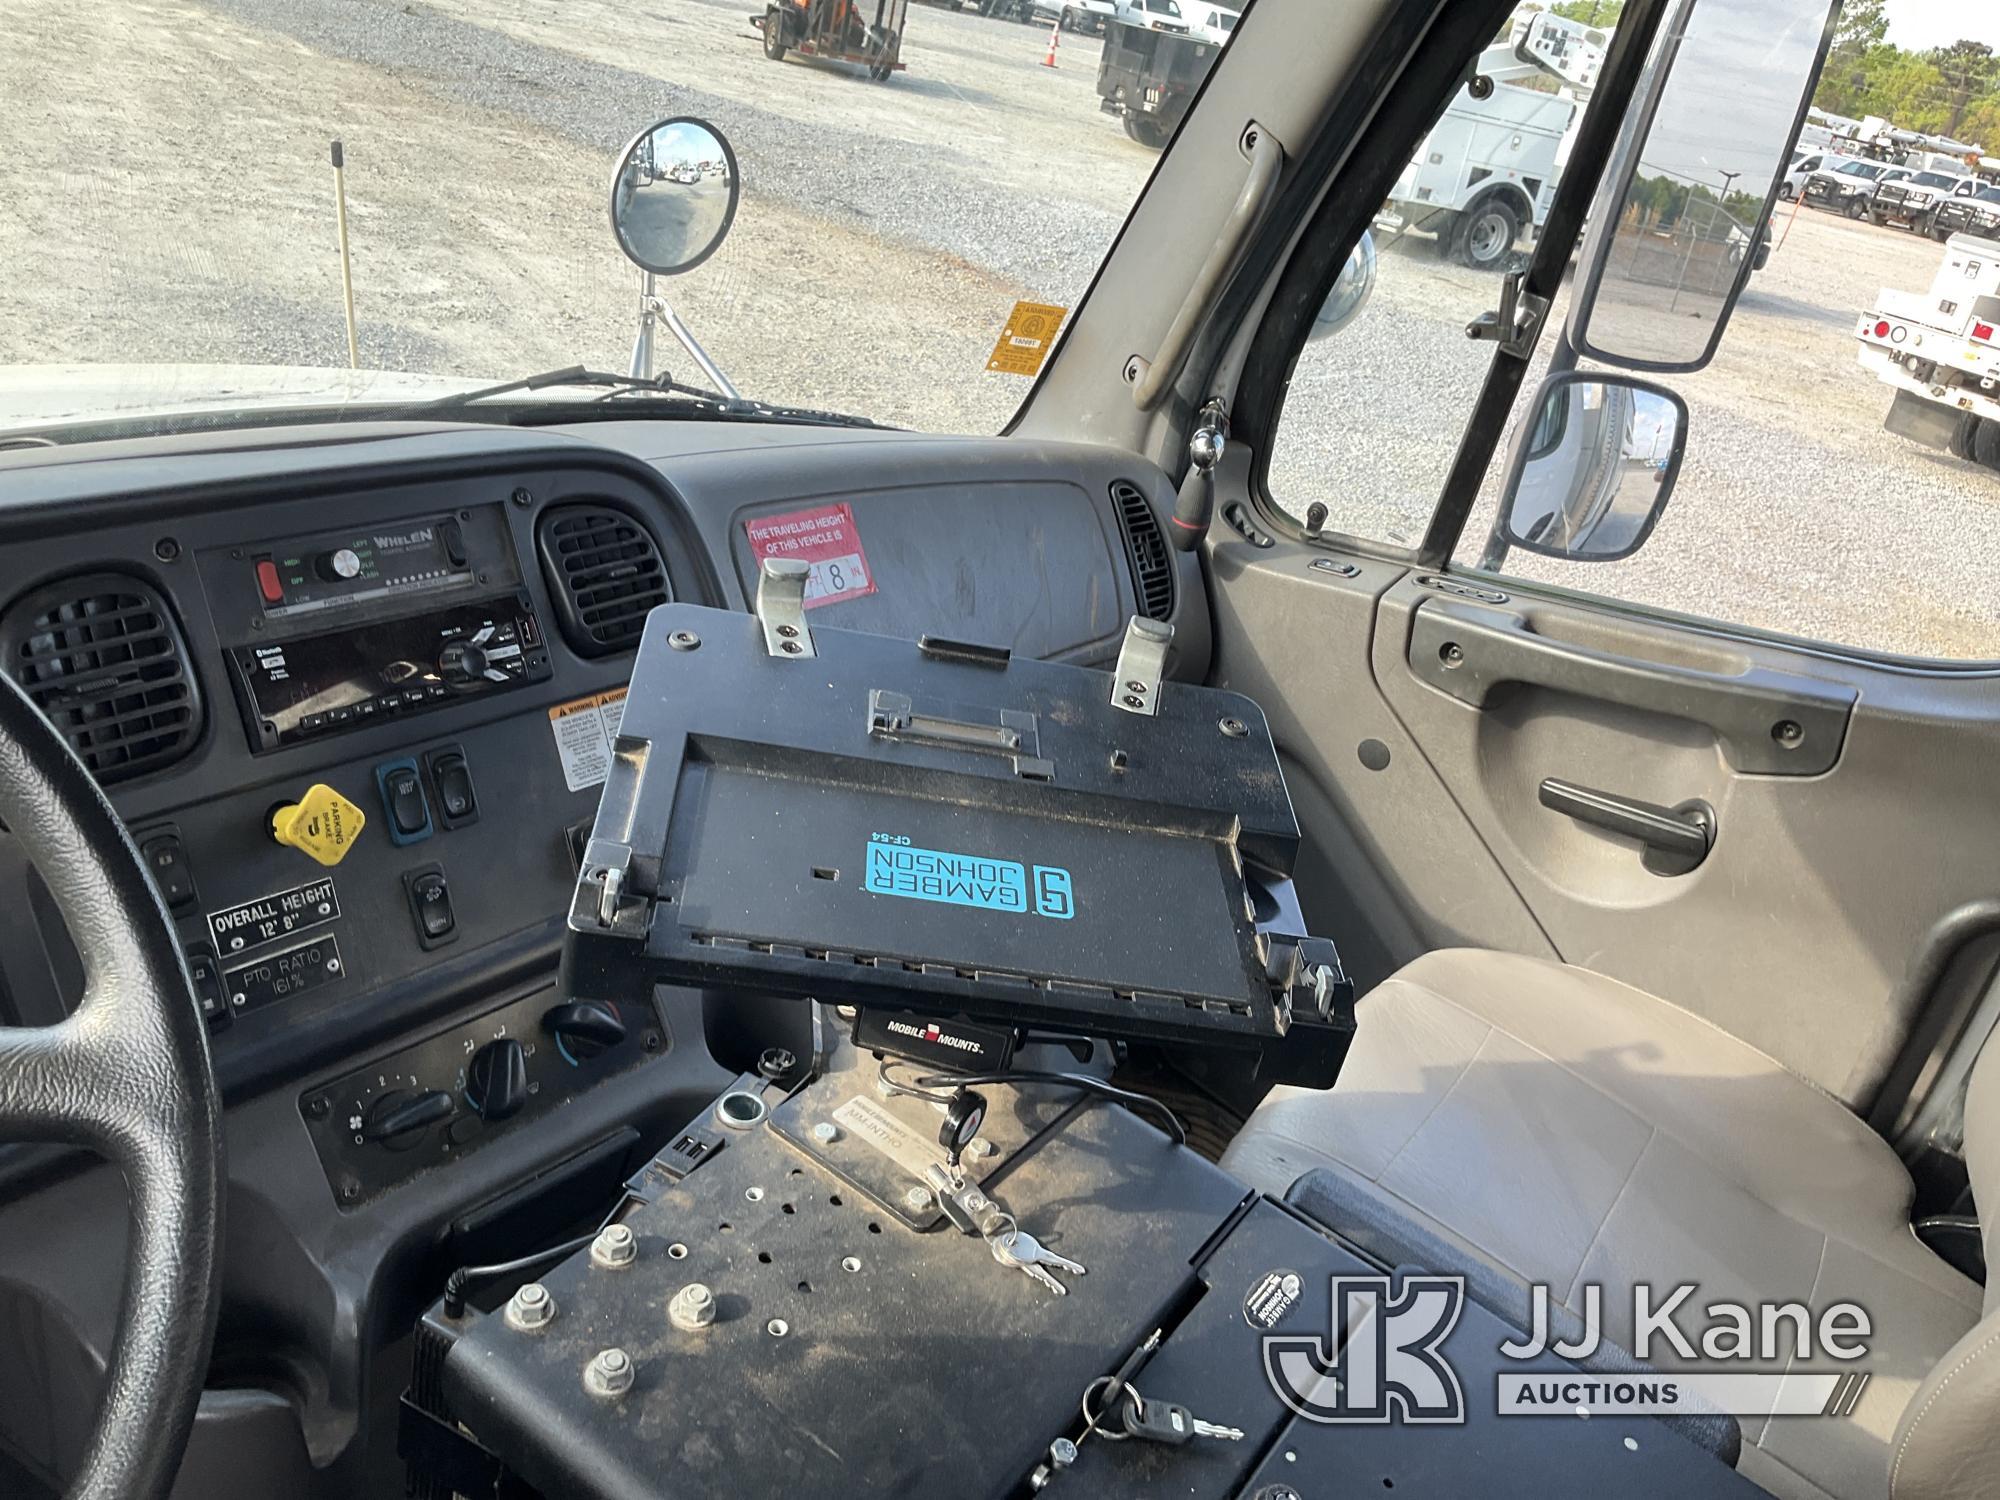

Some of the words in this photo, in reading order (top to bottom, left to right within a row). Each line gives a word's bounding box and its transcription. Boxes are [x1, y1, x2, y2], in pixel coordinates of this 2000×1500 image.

[373, 528, 433, 549] WHELEN
[751, 529, 770, 541] THE
[770, 520, 815, 536] TRAVELING
[816, 514, 846, 528] HEIGHT
[766, 542, 780, 554] OF
[780, 539, 799, 551] THIS
[799, 533, 833, 548] VEHICLE
[834, 530, 843, 541] IS
[829, 564, 844, 590] 8
[568, 702, 594, 713] WARNING
[322, 812, 333, 839] BRAKE
[330, 801, 344, 844] PARKING
[871, 831, 911, 846] CF-54
[874, 848, 1017, 884] JOHNSON
[873, 869, 1019, 906] GAMBER
[215, 903, 278, 932] OVERALL
[282, 884, 332, 911] HEIGHT
[259, 920, 278, 938] 12'
[243, 966, 271, 987] PTO
[279, 949, 321, 974] RATIO
[888, 1021, 926, 1039] MOBILE
[379, 1075, 386, 1086] 2
[410, 1075, 417, 1086] 3
[1258, 1289, 1283, 1321] JOHNSON
